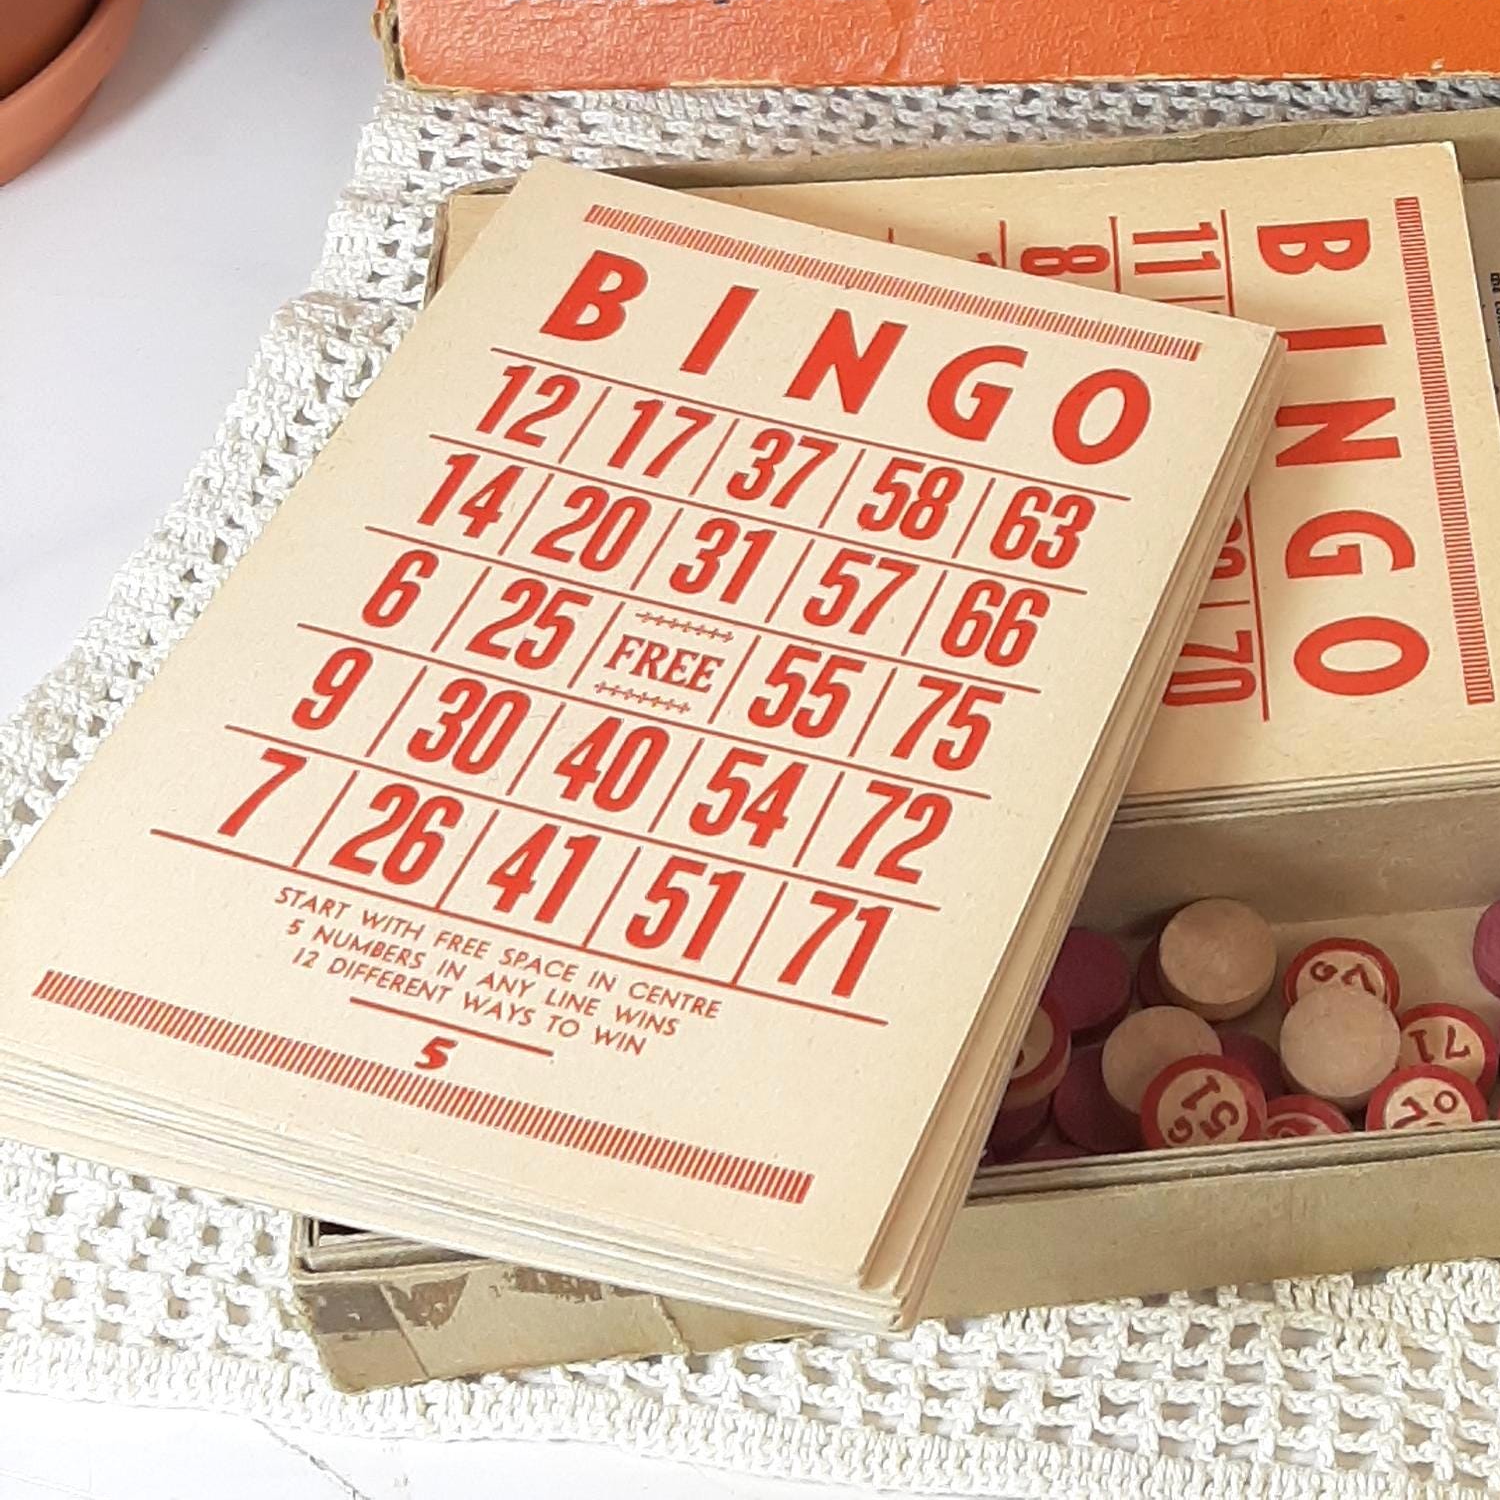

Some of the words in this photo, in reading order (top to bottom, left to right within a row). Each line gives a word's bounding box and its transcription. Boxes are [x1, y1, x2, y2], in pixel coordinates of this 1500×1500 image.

[1020, 244, 1110, 275] 8
[1132, 221, 1221, 275] 11
[539, 250, 1150, 465] BINGO
[476, 365, 579, 447] 12
[607, 399, 714, 478] 17
[725, 428, 837, 509] 37
[856, 457, 963, 540] 58
[988, 486, 1094, 570] 63
[1257, 217, 1430, 695] BINGO
[417, 453, 522, 538] 14
[532, 485, 650, 573] 20
[668, 518, 775, 604] 31
[802, 548, 917, 635] 57
[939, 579, 1049, 668] 66
[361, 550, 438, 628] 6
[466, 577, 591, 670] 25
[607, 635, 722, 692] FREE
[746, 644, 864, 739] 55
[891, 675, 1004, 771] 75
[1163, 630, 1256, 706] 70
[291, 647, 372, 730] 9
[406, 678, 530, 775] 30
[555, 716, 668, 812] 40
[688, 747, 806, 848] 54
[837, 780, 952, 884] 72
[219, 748, 305, 836] 7
[330, 782, 463, 885] 26
[487, 824, 599, 923] 41
[625, 856, 743, 962] 51
[778, 891, 890, 998] 71
[274, 886, 351, 919] START
[361, 909, 425, 941] WITH
[432, 929, 491, 959] FREE
[498, 947, 579, 982] SPACE
[587, 970, 616, 992] IN
[628, 981, 722, 1019] CENTRE
[286, 918, 305, 935] 5
[311, 924, 426, 969] NUMBERS
[436, 958, 467, 981] IN
[475, 971, 536, 998] ANY
[543, 987, 600, 1016] LINE
[615, 1004, 680, 1036] WINS
[291, 947, 319, 968] 12
[326, 957, 453, 1003] DIFFERENT
[463, 990, 536, 1026] WAYS
[546, 1014, 579, 1037] TO
[594, 1024, 646, 1055] WIN
[414, 1035, 458, 1070] 5
[1181, 1074, 1240, 1139] 51
[1408, 1025, 1470, 1063] 71
